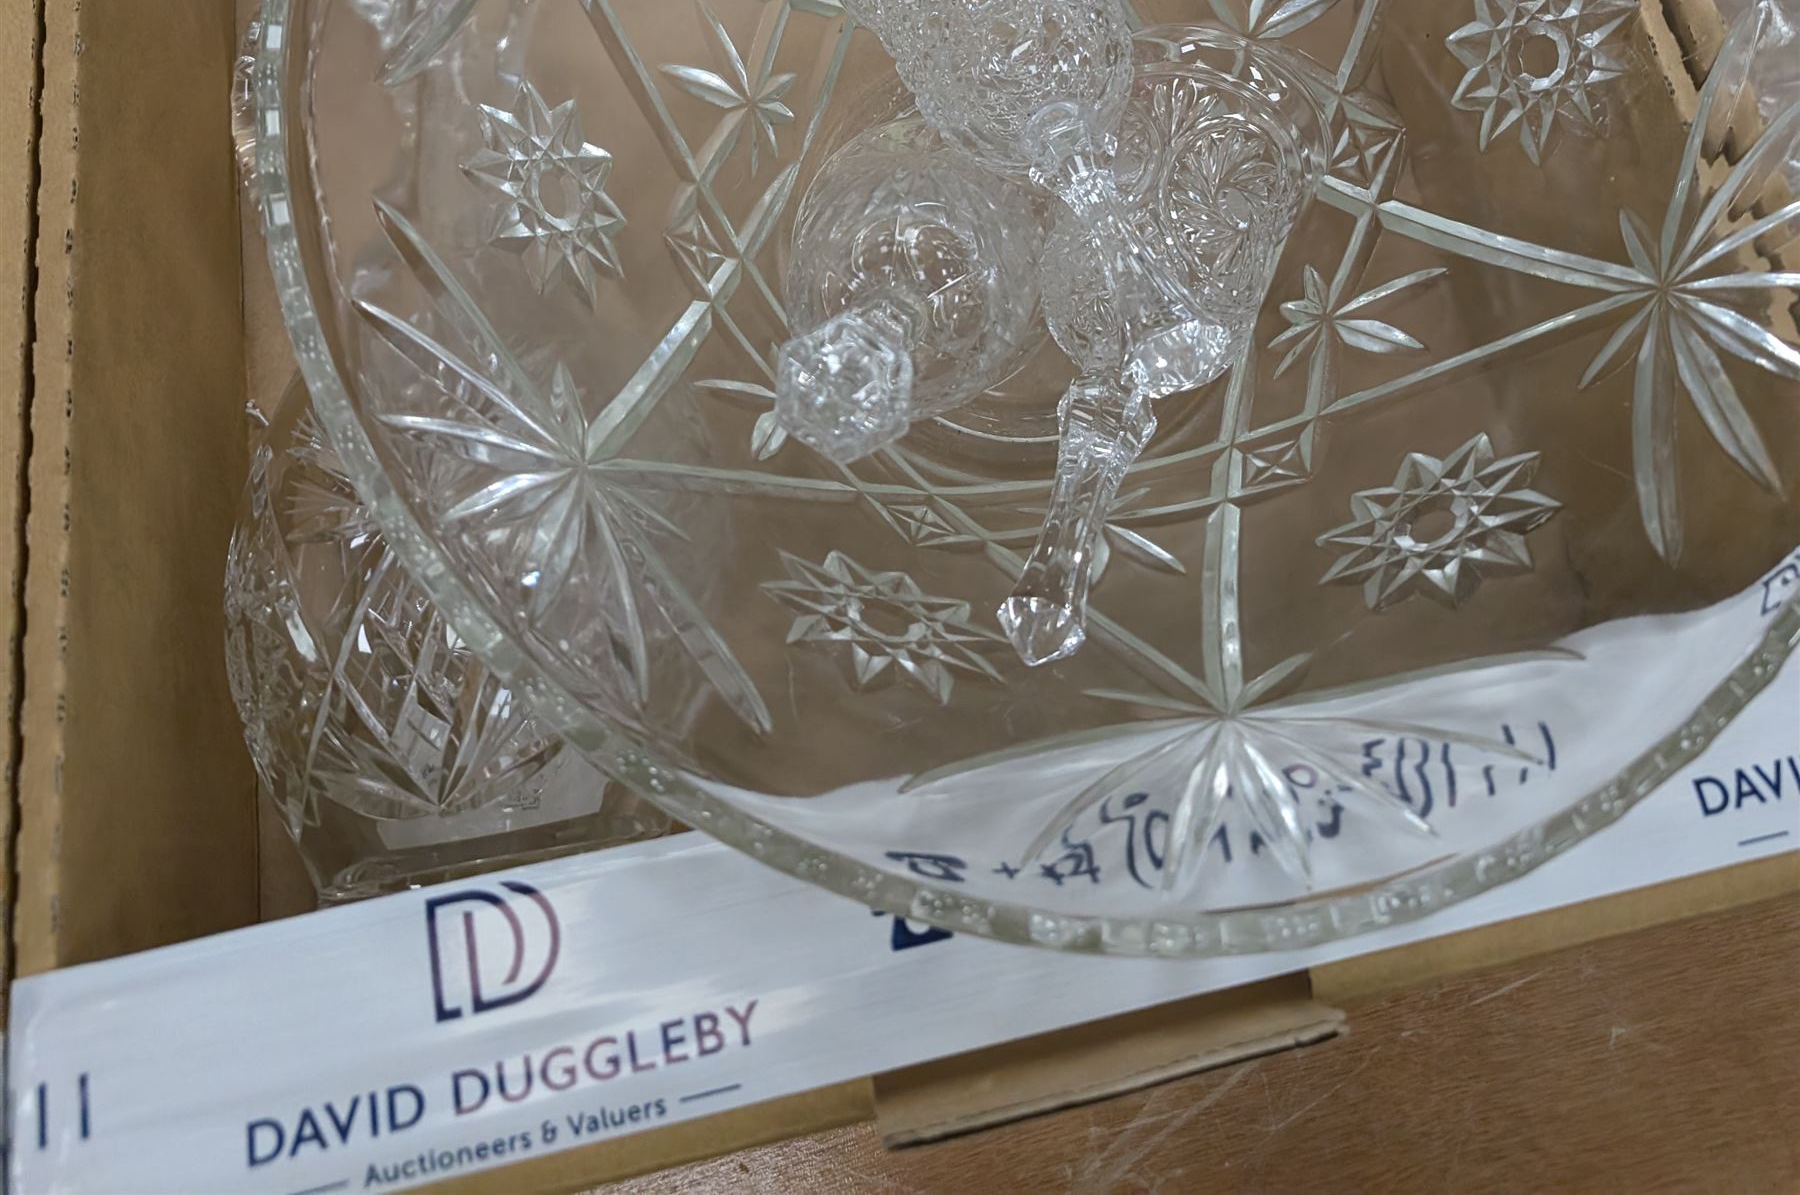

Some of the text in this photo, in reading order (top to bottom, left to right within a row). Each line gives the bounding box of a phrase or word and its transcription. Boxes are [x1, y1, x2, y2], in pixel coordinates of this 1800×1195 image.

[246, 998, 761, 1168] DAVID DUGGLEBY
[363, 1095, 668, 1189] Auctioneers & Valuers
